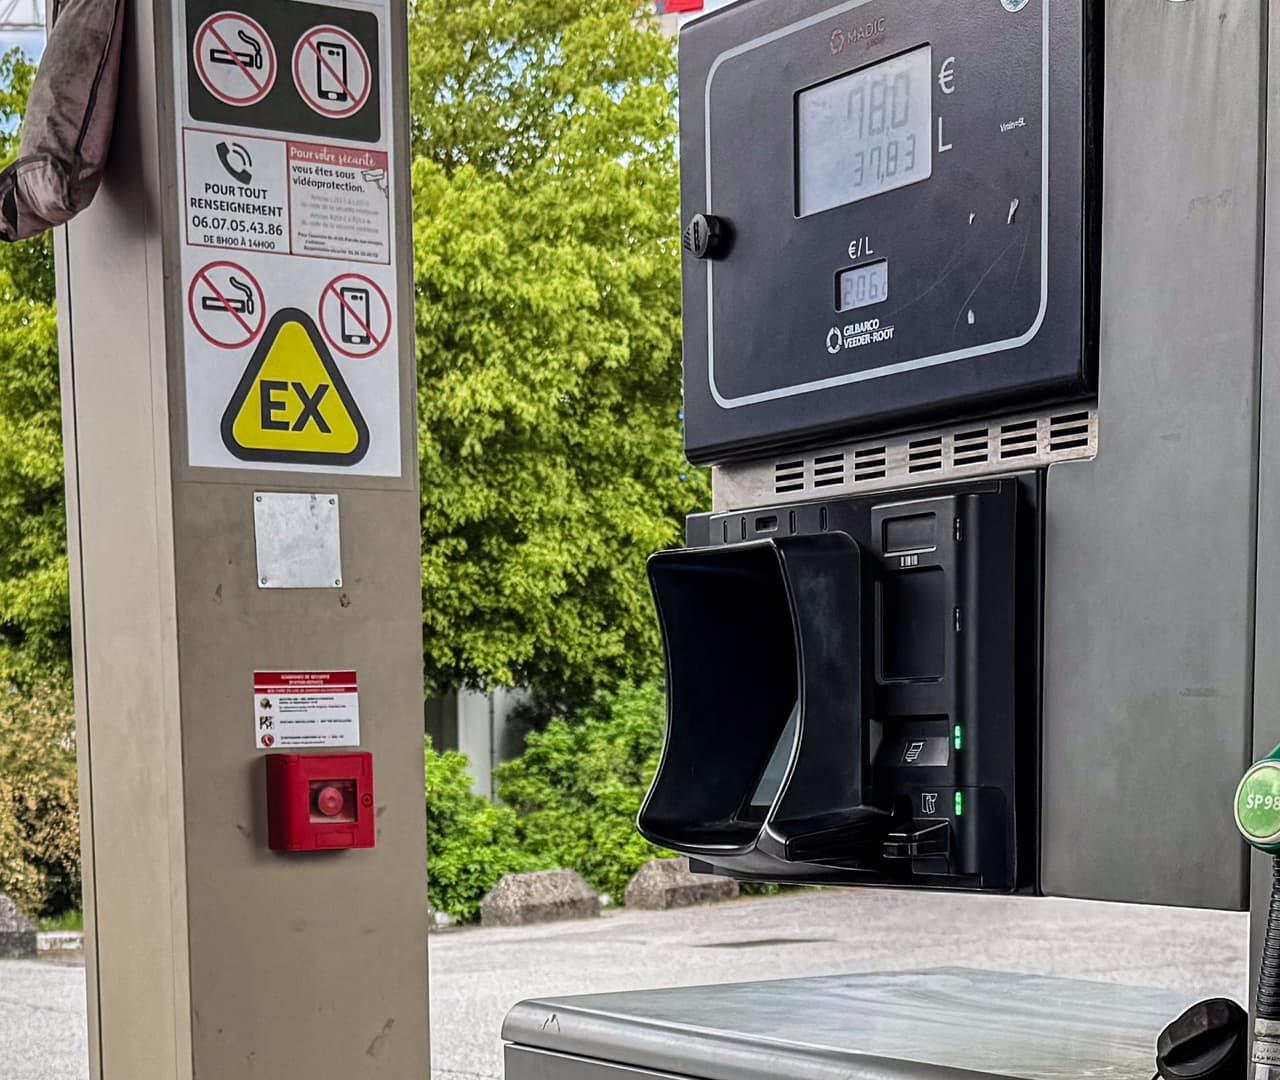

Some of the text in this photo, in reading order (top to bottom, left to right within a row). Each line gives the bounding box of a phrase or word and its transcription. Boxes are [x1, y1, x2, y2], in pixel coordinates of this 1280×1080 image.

[938, 57, 955, 94] €
[938, 116, 953, 152] L
[290, 146, 314, 158] Pour
[292, 164, 355, 180] vous êtes sous
[205, 183, 268, 200] POUR TOUT
[293, 176, 365, 193] vidéoprotection.
[190, 197, 283, 218] RENSEIGNEMENT
[192, 215, 283, 236] 06.07.05.43.86
[203, 234, 215, 244] DE
[240, 235, 247, 247] À
[248, 238, 276, 250] 14H00
[843, 318, 880, 336] GILBARCO
[844, 327, 894, 349] VEEDER-ROOT
[259, 379, 332, 434] EX
